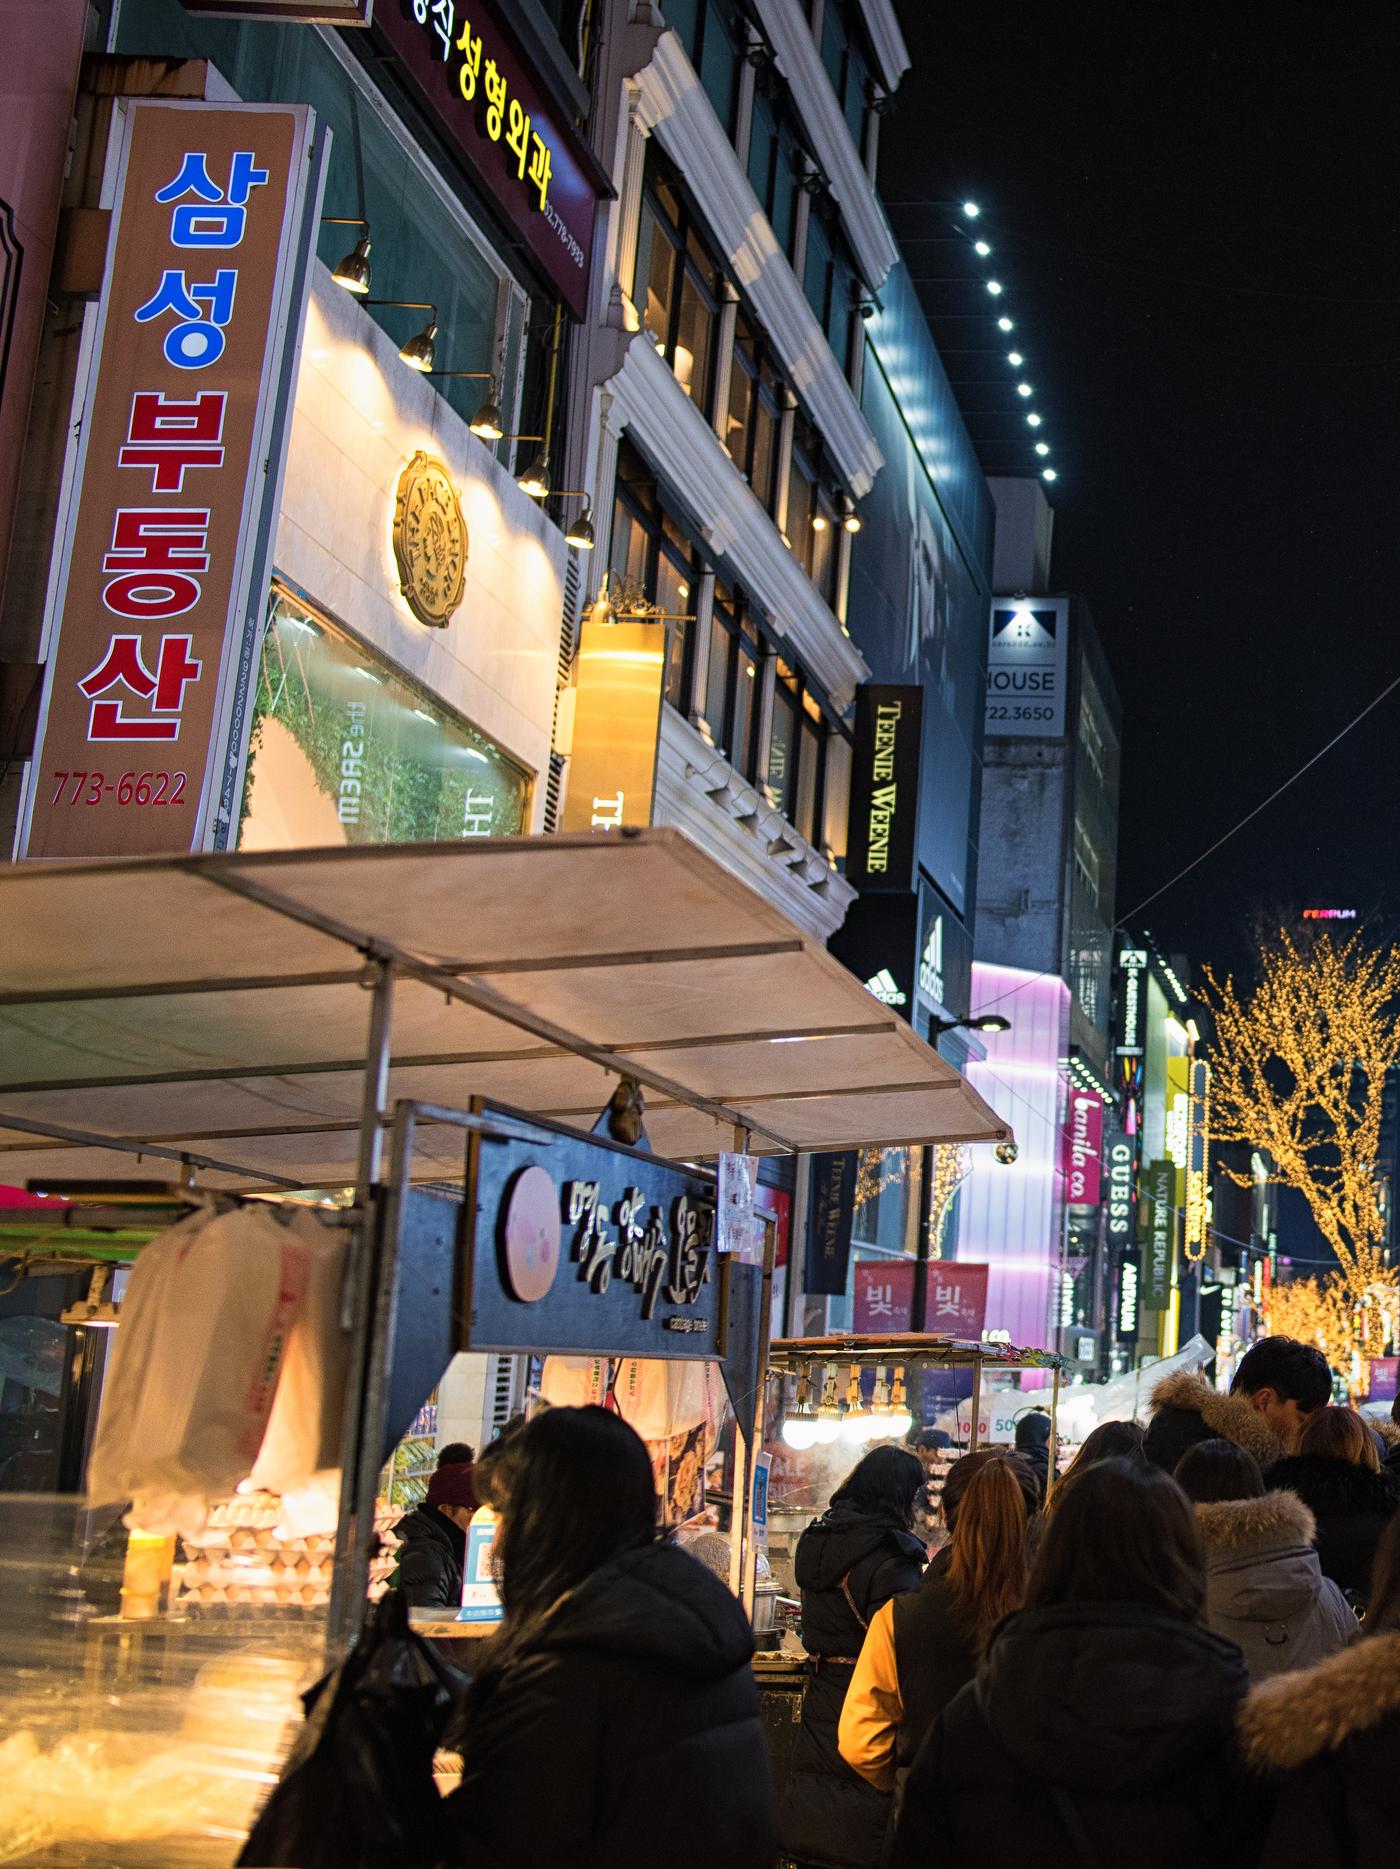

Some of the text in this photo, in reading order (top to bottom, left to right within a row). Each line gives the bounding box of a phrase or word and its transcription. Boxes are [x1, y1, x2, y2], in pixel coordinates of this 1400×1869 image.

[456, 19, 553, 213] 성형외과
[79, 152, 269, 741] 삼성부동산
[52, 771, 188, 806] 773-6622
[866, 700, 902, 874] TEENIE WEENIE
[1071, 1096, 1101, 1168] banila
[1109, 1143, 1131, 1234] GUESS
[1151, 1171, 1169, 1299] NATURE REPUBLIC
[866, 1284, 893, 1317] 빛
[935, 1284, 961, 1317] 빛
